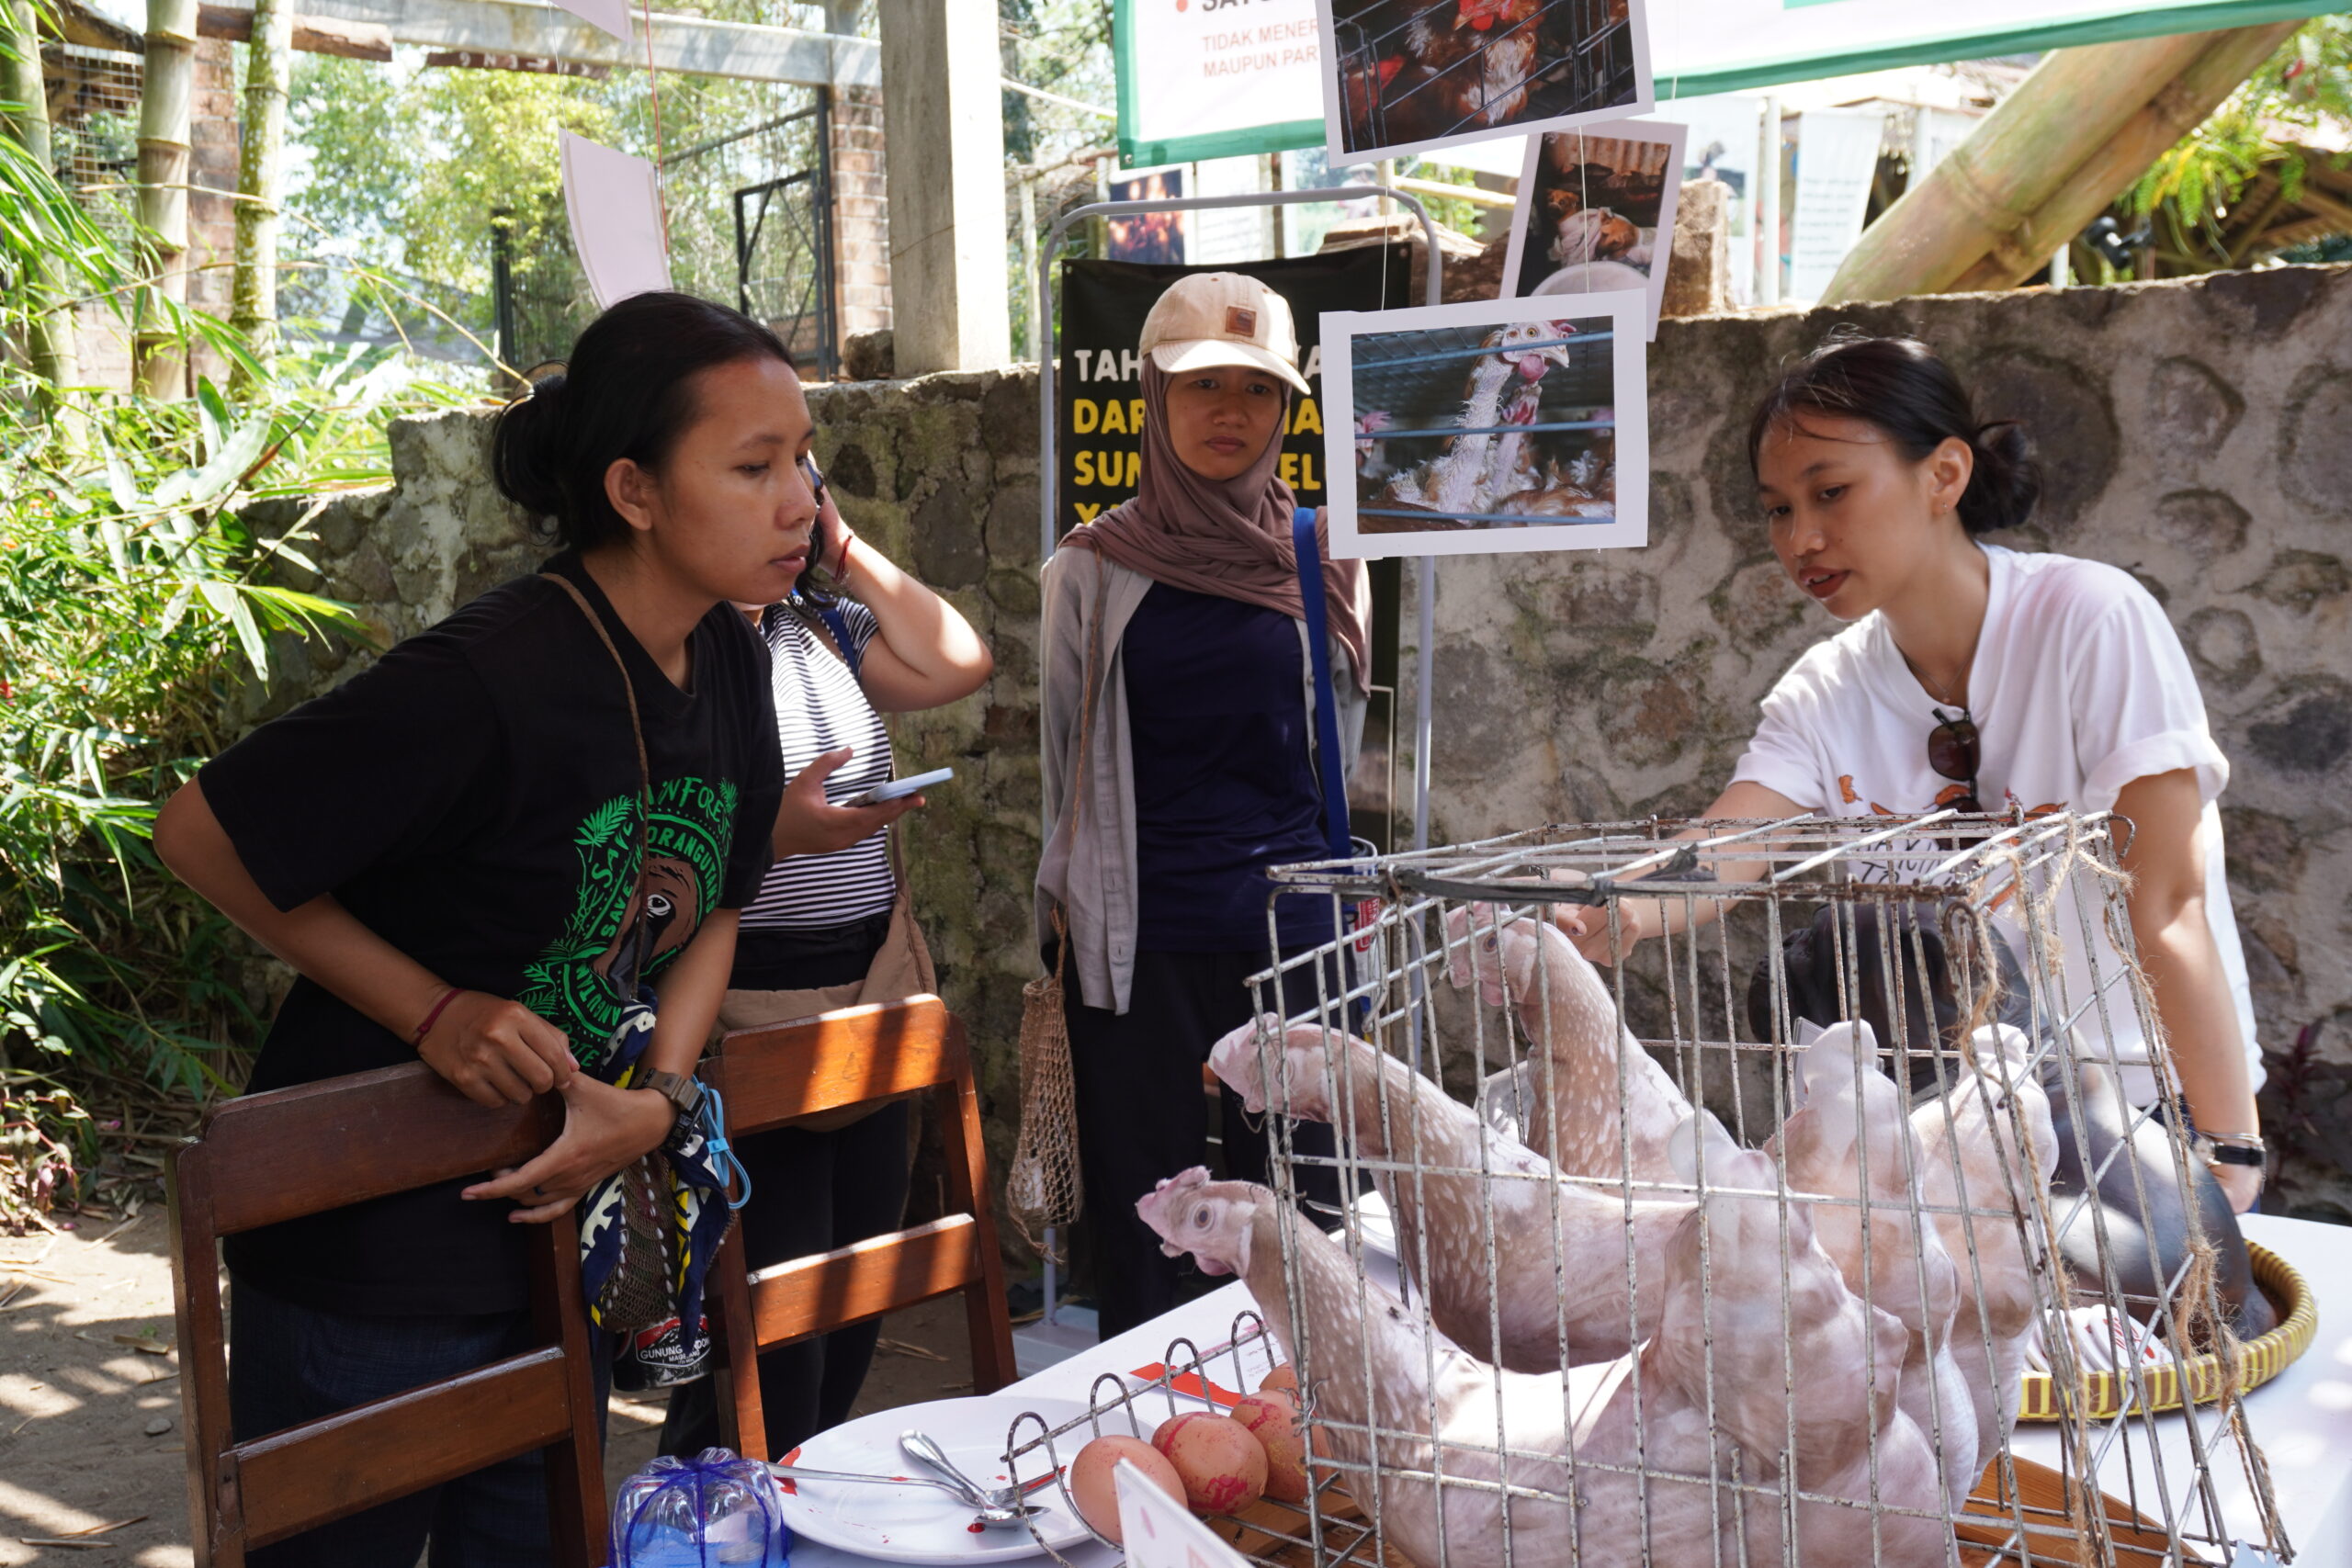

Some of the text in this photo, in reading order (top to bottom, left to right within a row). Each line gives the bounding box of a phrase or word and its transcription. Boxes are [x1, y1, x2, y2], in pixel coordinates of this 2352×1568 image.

[1202, 29, 1253, 52] TIDAK
[1204, 51, 1277, 78] MAUPUN
[601, 879, 634, 938] SAVE
[647, 825, 718, 915] ORANGUTANS
[640, 1344, 684, 1359] GUNUNG
